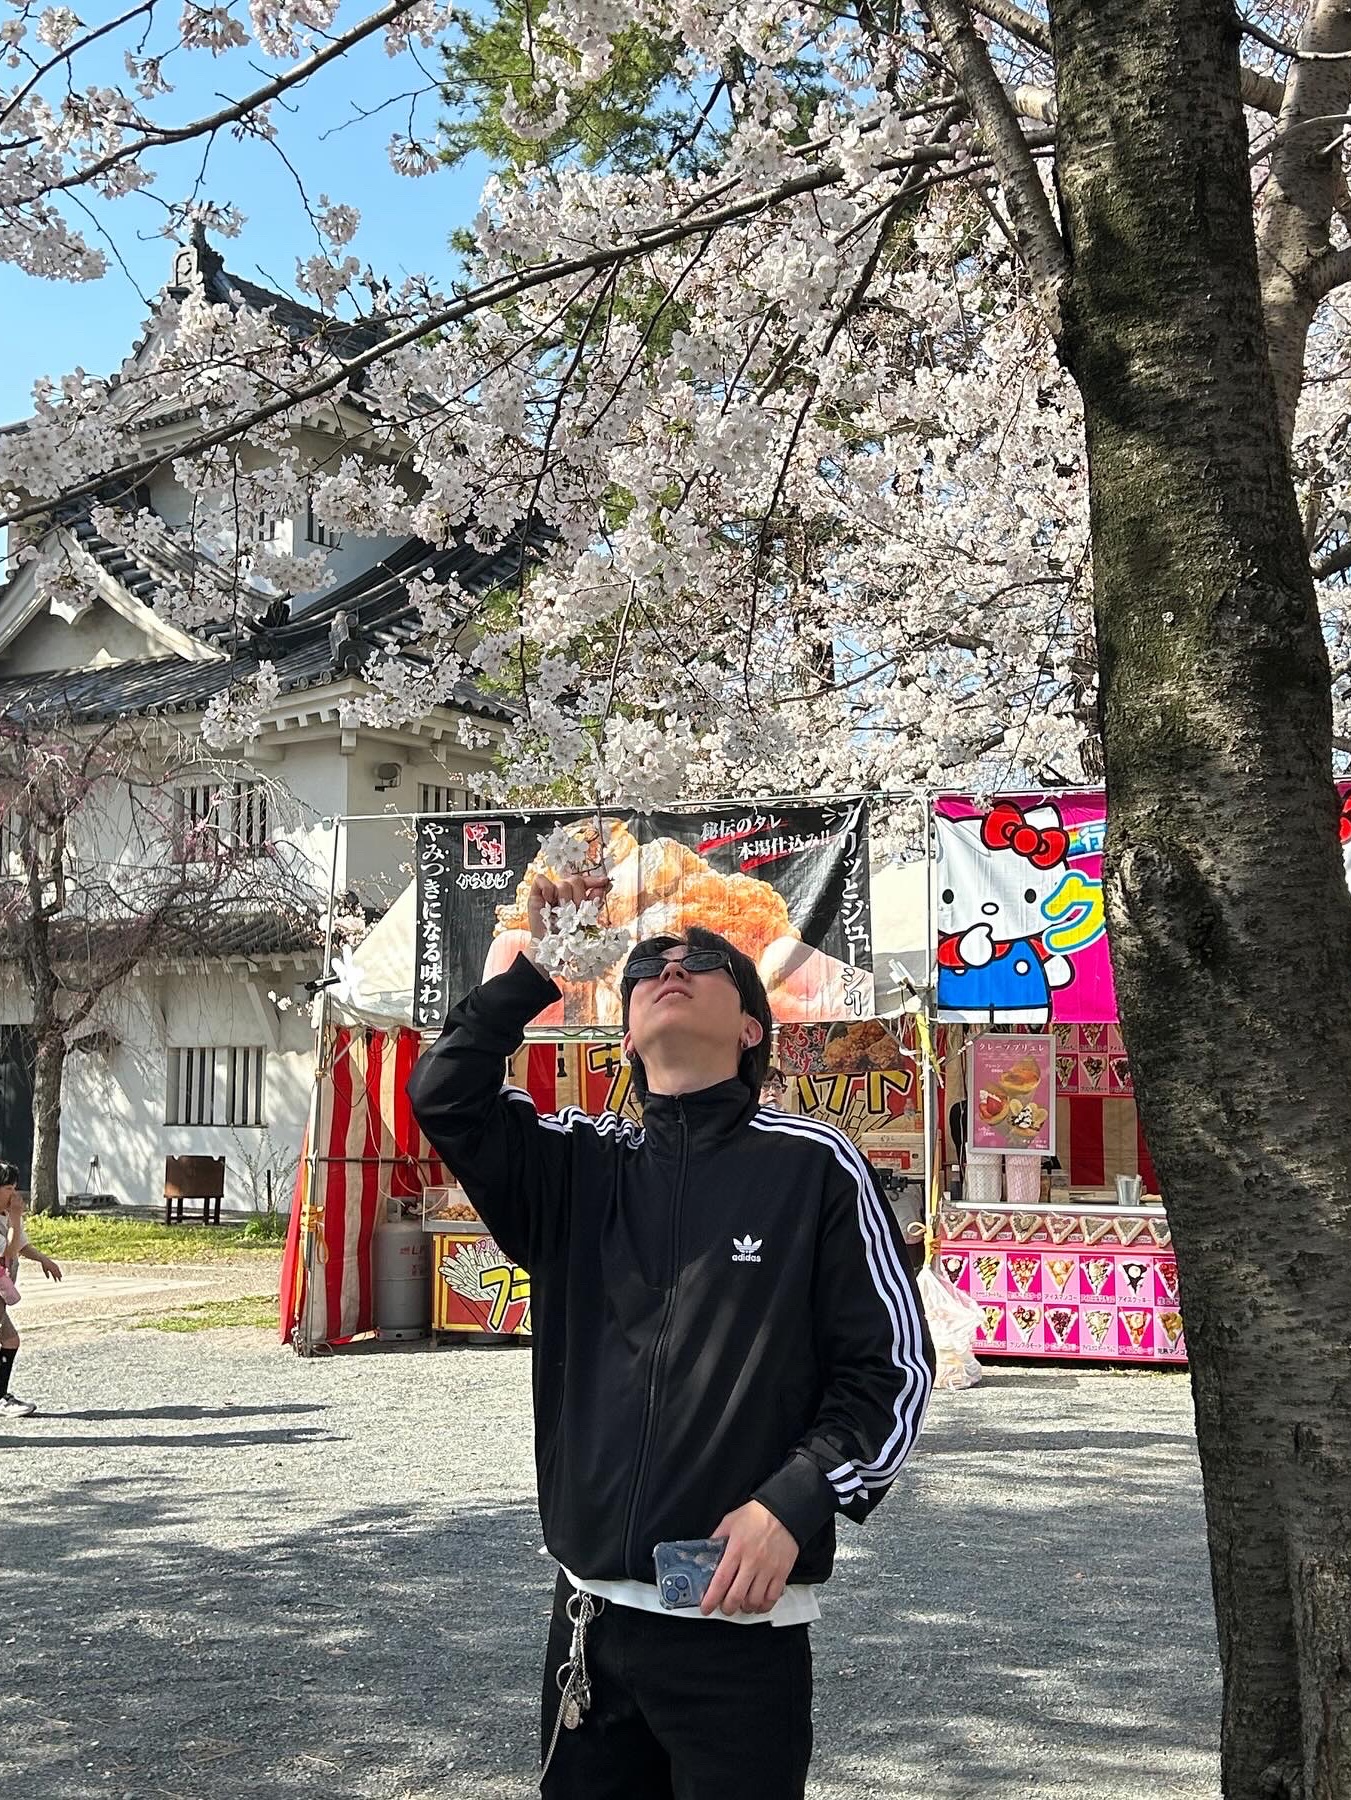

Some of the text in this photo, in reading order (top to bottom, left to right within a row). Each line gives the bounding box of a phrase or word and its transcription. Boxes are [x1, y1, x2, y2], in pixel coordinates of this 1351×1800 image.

[700, 814, 782, 841] 秘伝のタレ
[420, 822, 443, 1024] やみつきになる味わい
[838, 803, 870, 1017] カリッとジューシー
[732, 1253, 761, 1262] adidas
